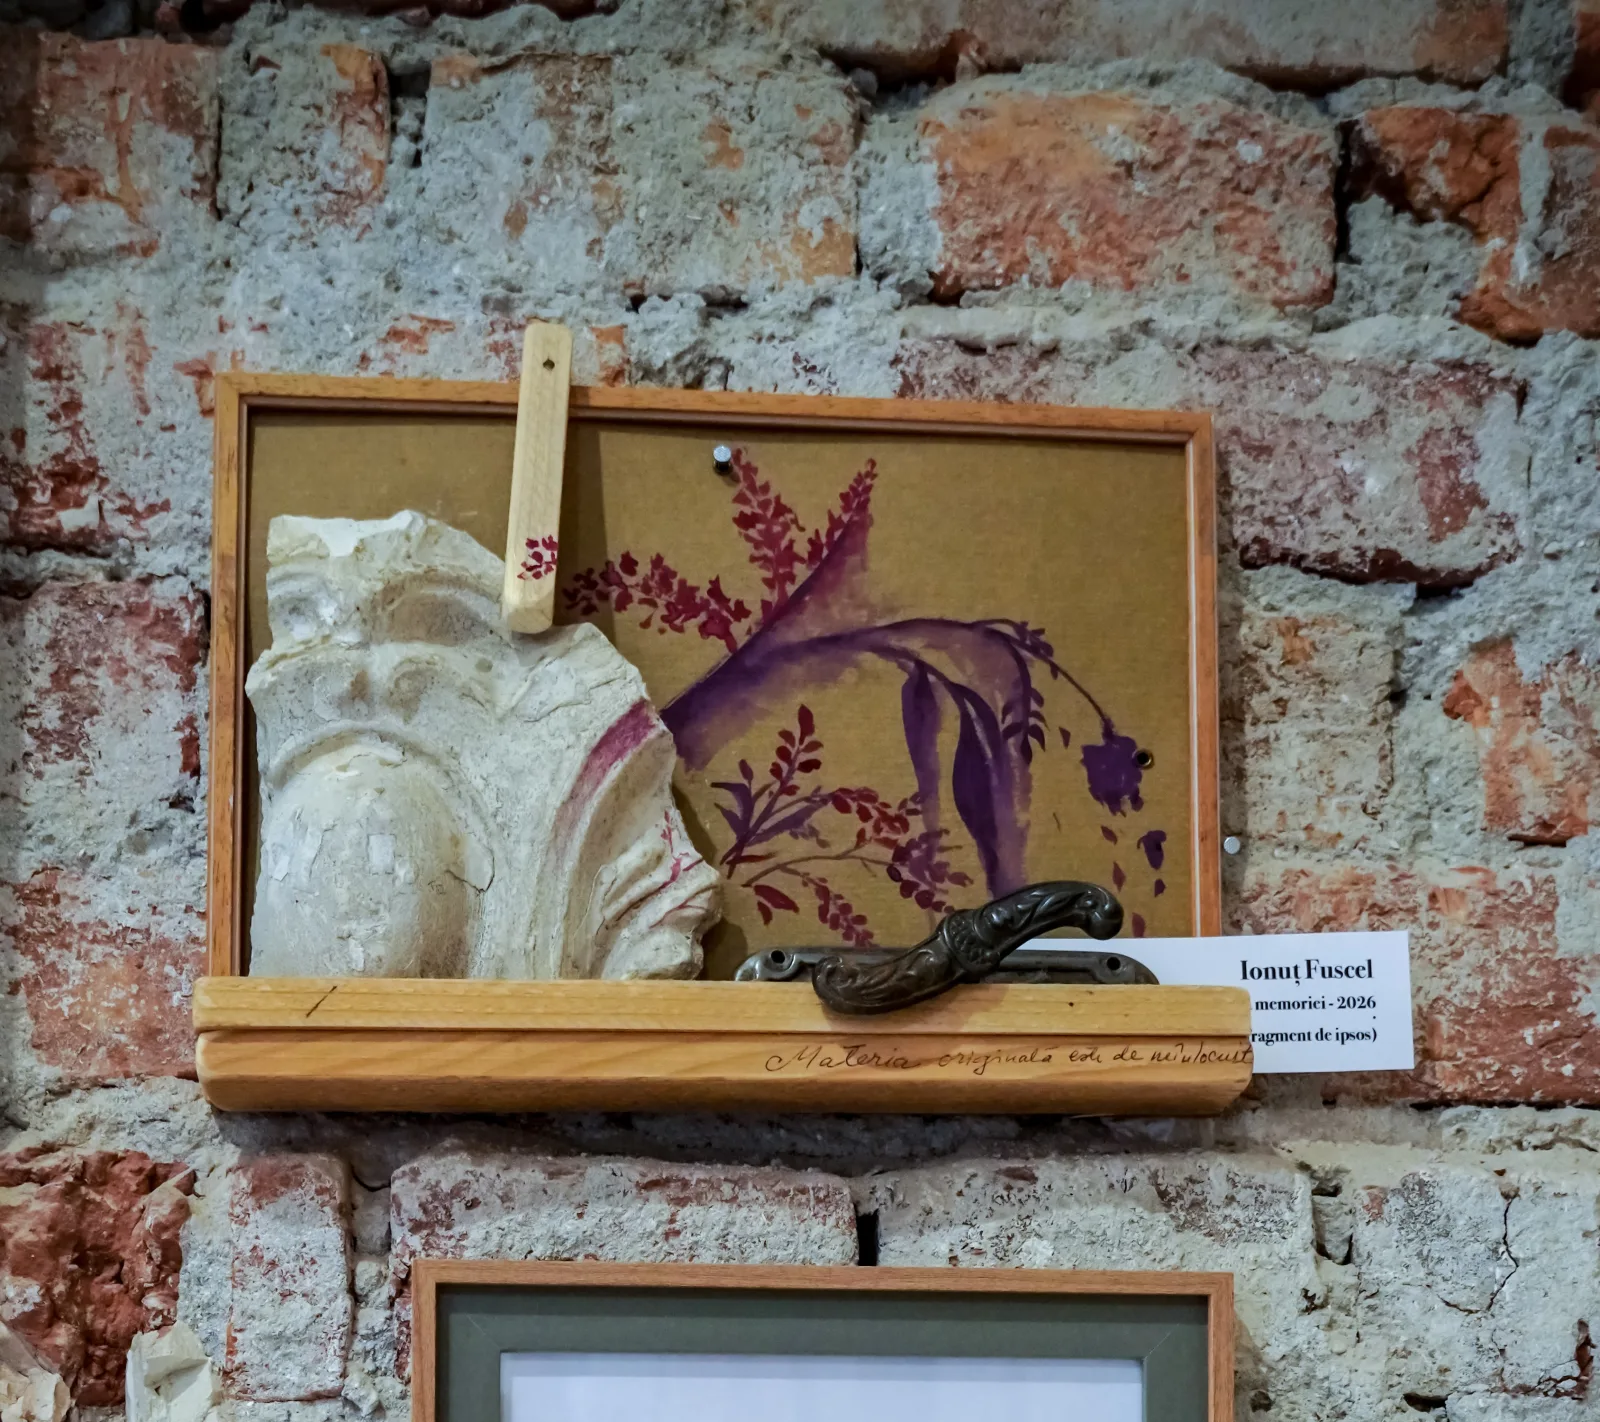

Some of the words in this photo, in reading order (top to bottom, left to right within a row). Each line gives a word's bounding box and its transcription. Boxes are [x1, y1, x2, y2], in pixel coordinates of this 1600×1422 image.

[1240, 960, 1302, 987] Ionuț
[1305, 958, 1374, 980] Fuscel
[1255, 996, 1326, 1011] memoriei
[1336, 996, 1377, 1010] 2026
[1250, 1029, 1312, 1046] ragment
[1315, 1028, 1332, 1042] de
[1335, 1027, 1378, 1045] ipsos)
[765, 1043, 921, 1072] Materia
[1113, 1046, 1145, 1062] de
